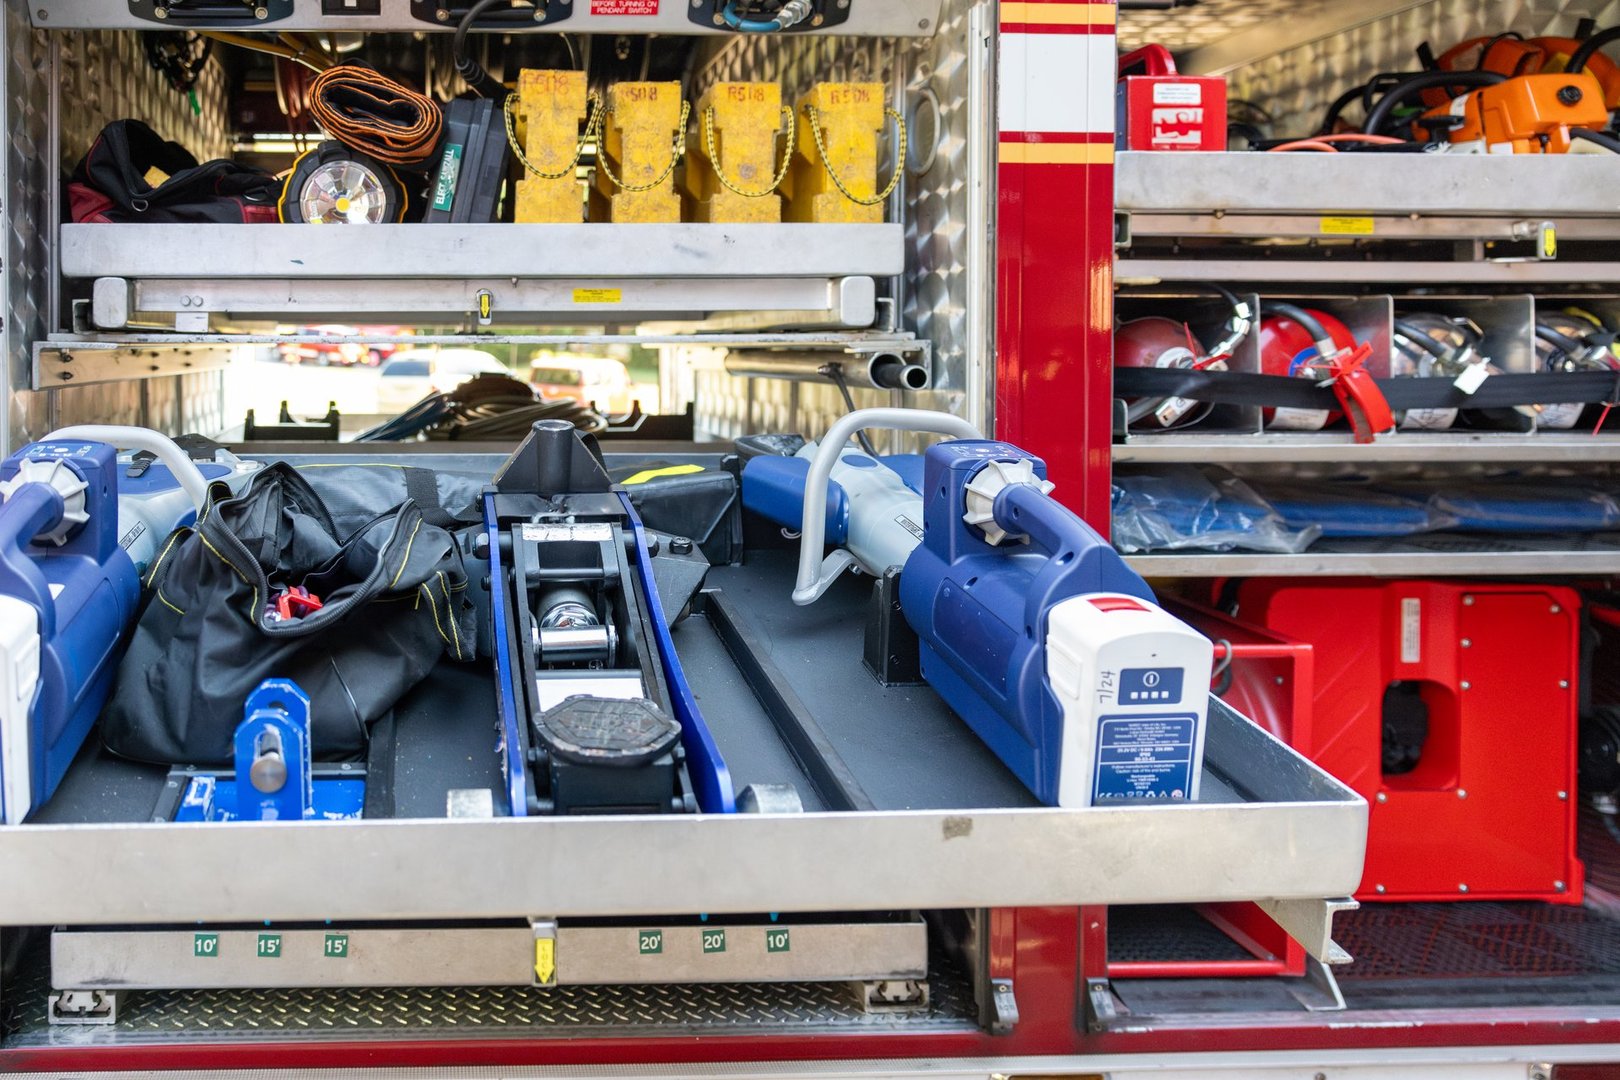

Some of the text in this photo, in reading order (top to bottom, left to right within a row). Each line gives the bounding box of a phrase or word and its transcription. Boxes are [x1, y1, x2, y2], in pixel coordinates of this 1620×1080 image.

[195, 938, 217, 953] 10'
[258, 939, 280, 953] 15'
[325, 939, 347, 954] 15'
[640, 935, 661, 950] 20'
[703, 933, 724, 949] 20'
[768, 933, 788, 948] 10'
